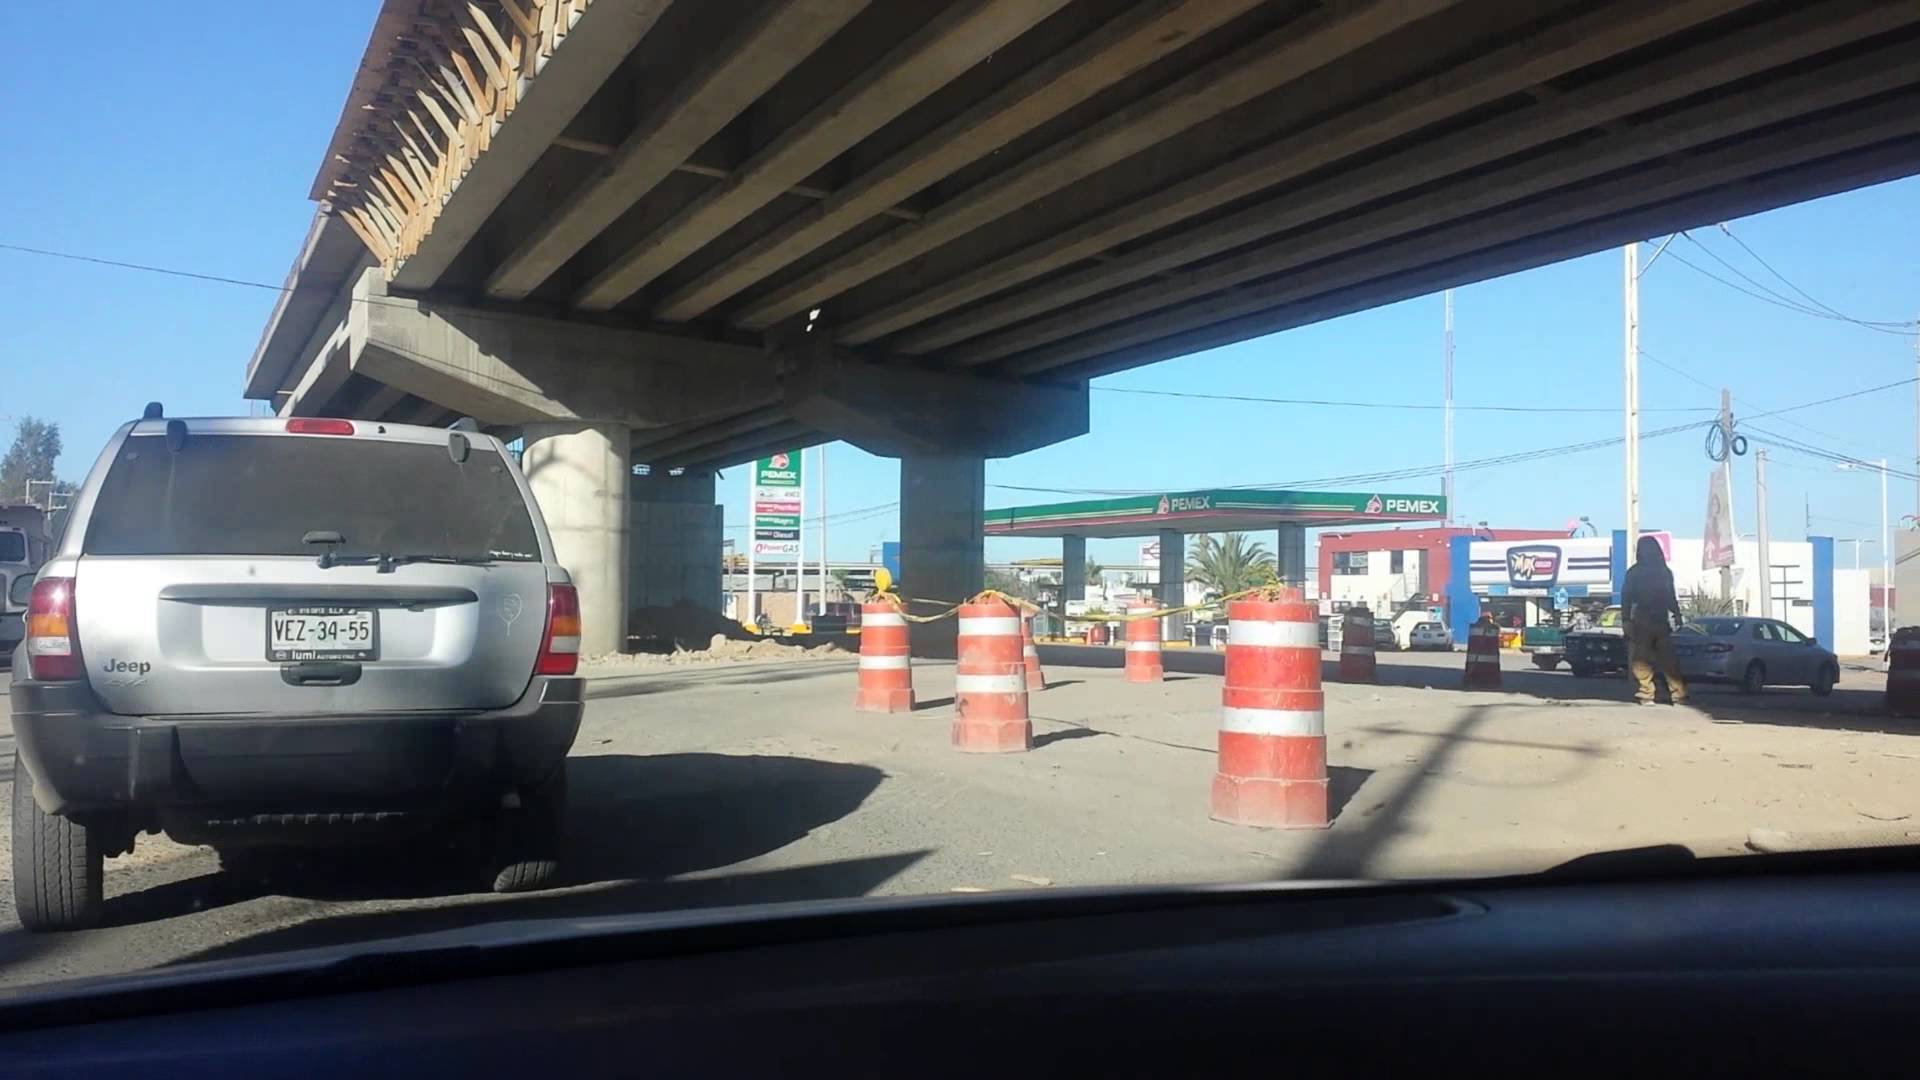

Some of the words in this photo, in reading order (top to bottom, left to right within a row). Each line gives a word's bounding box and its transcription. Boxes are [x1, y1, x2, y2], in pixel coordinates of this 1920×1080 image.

[761, 470, 797, 479] PEMEX
[1171, 496, 1210, 511] PEMEX
[1386, 499, 1439, 513] PEMEX
[274, 619, 370, 641] VEZ-34-55
[102, 658, 151, 676] Jeep
